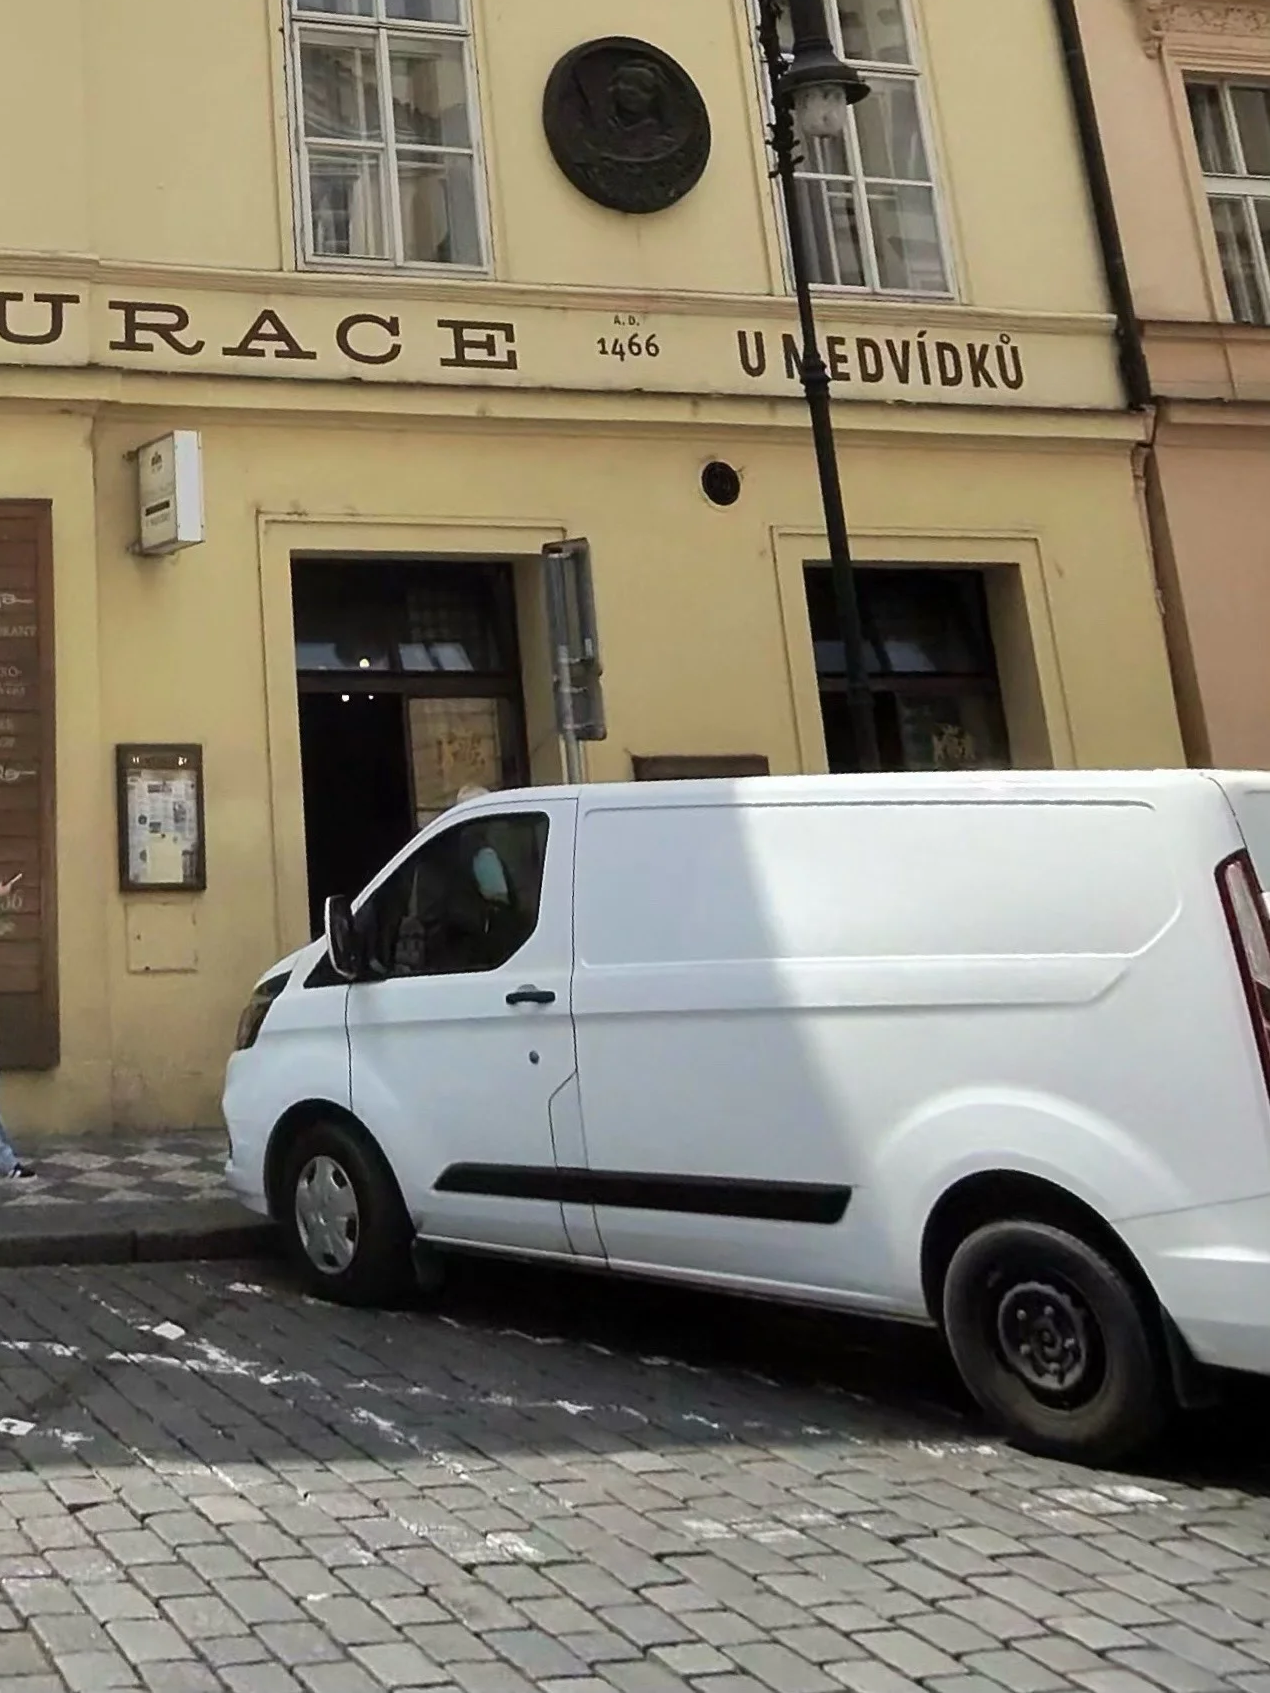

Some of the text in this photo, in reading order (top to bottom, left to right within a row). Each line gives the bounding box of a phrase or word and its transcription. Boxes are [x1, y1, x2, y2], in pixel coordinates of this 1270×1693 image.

[614, 314, 640, 326] A.D.
[596, 332, 660, 362] 1466
[737, 330, 766, 378] U
